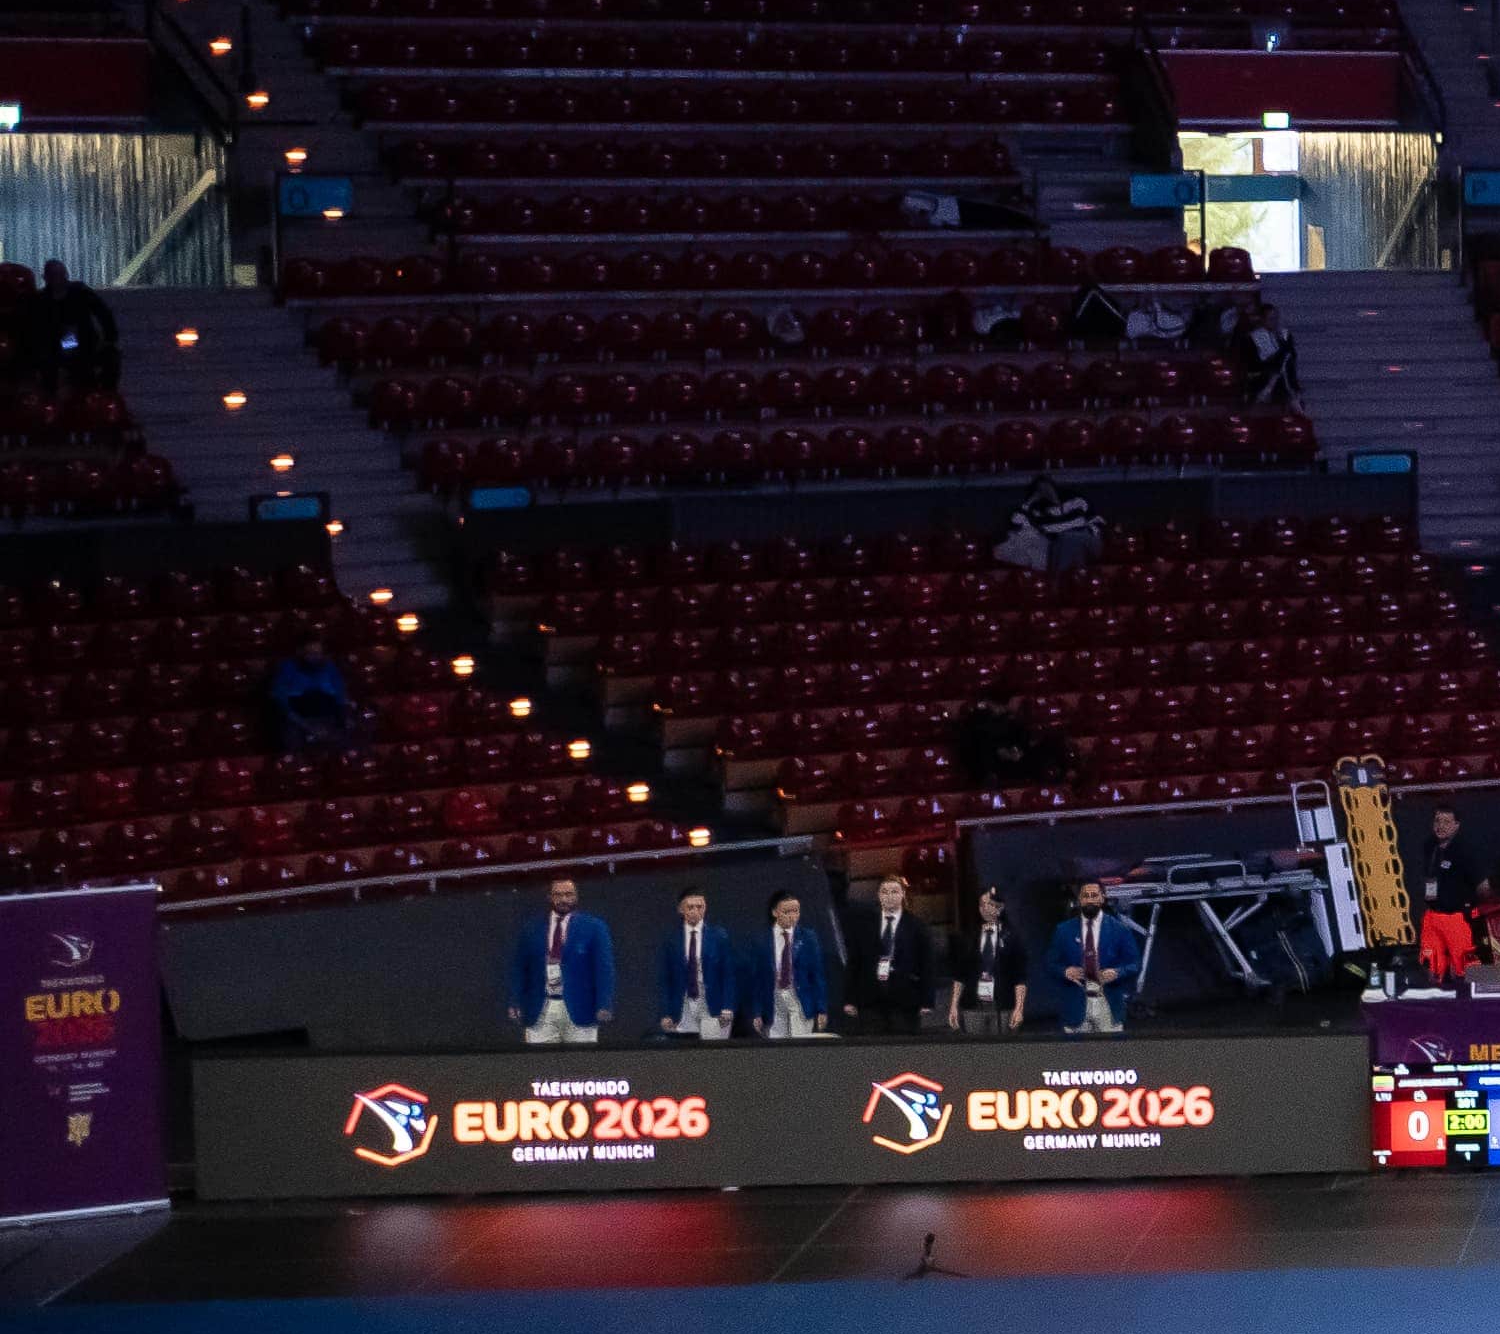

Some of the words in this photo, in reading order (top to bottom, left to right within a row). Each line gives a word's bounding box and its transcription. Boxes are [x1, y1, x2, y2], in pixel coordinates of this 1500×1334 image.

[24, 989, 121, 1022] EURO
[1042, 1070, 1137, 1085] TAEKWONDO
[531, 1081, 629, 1096] TAEKWONDO
[967, 1089, 1098, 1131] EURO
[1101, 1086, 1214, 1128] 2026
[453, 1100, 589, 1143] EURO
[592, 1096, 709, 1141] 2026
[1408, 1110, 1429, 1140] 0
[1449, 1114, 1485, 1130] 2:00
[1024, 1134, 1097, 1150] GERMANY
[1101, 1133, 1160, 1148] MUNICH
[512, 1145, 589, 1162] GERMANY
[593, 1144, 654, 1159] MUNICH
